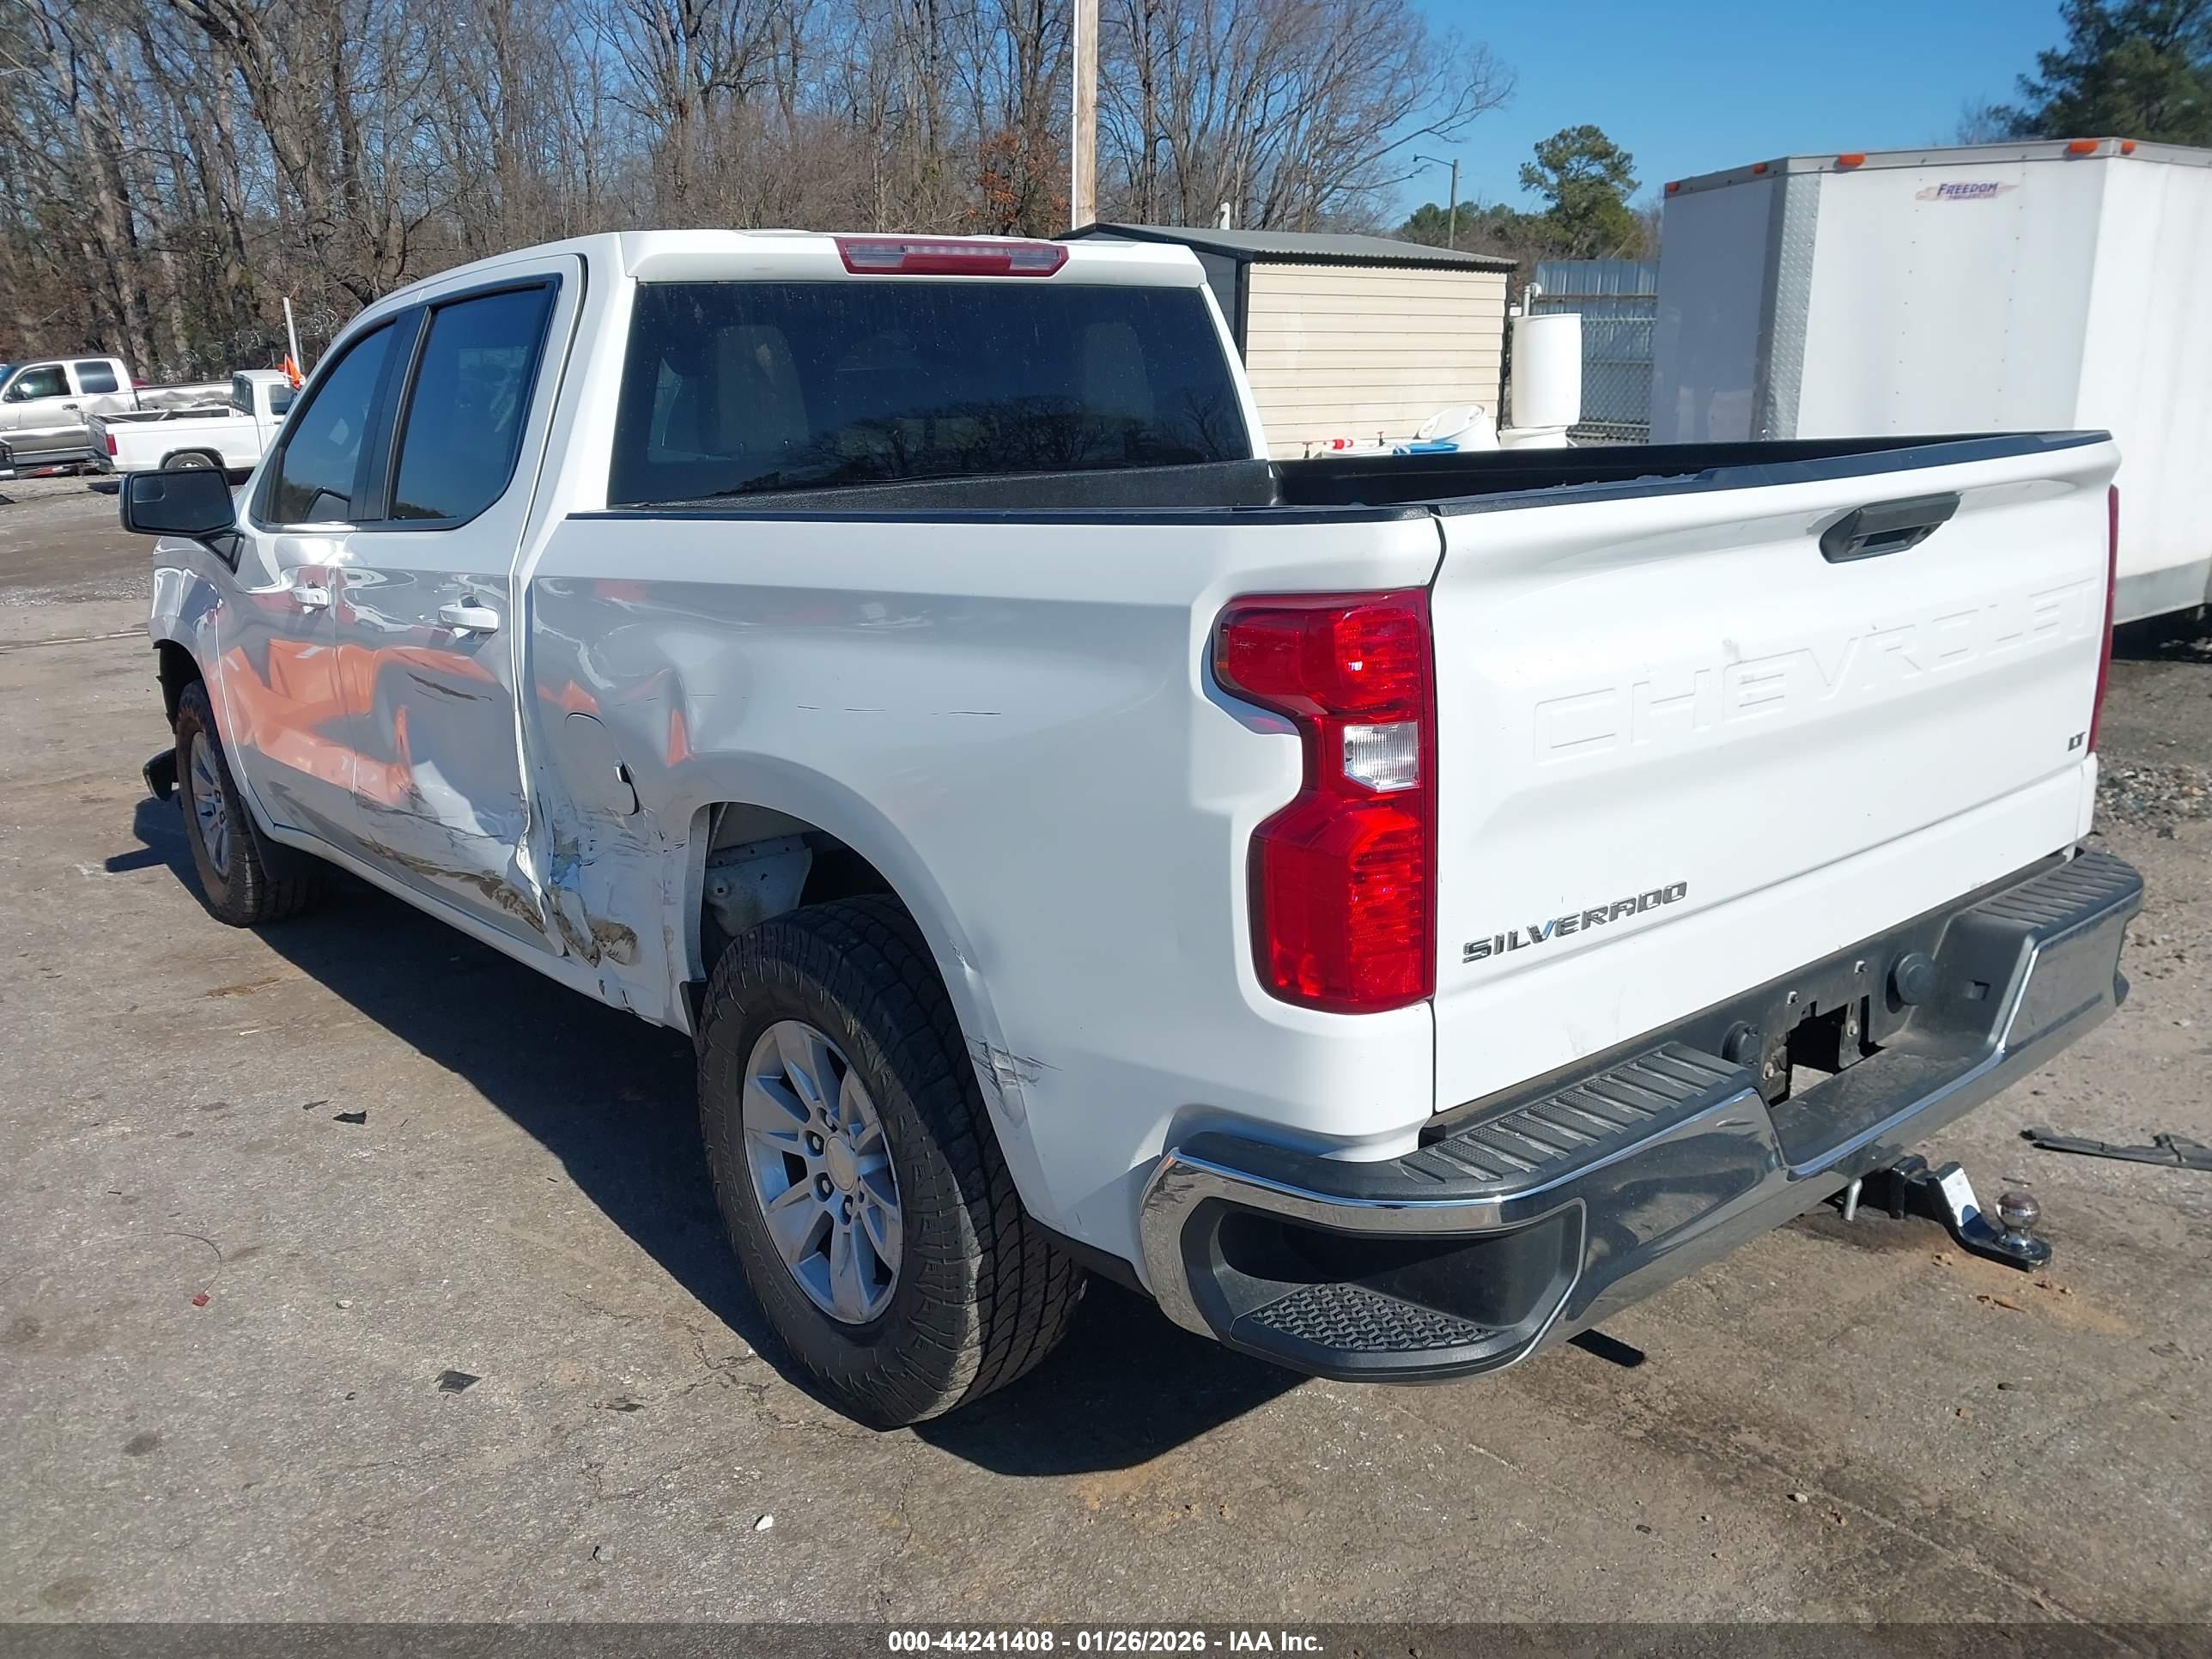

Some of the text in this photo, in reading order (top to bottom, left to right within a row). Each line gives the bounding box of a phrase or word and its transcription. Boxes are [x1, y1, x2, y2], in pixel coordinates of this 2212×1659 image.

[1937, 183, 1998, 196] FREEDOM
[1534, 577, 2096, 766] CHEVROLET
[2068, 731, 2087, 752] LT
[1462, 880, 1687, 963] SILVERADO
